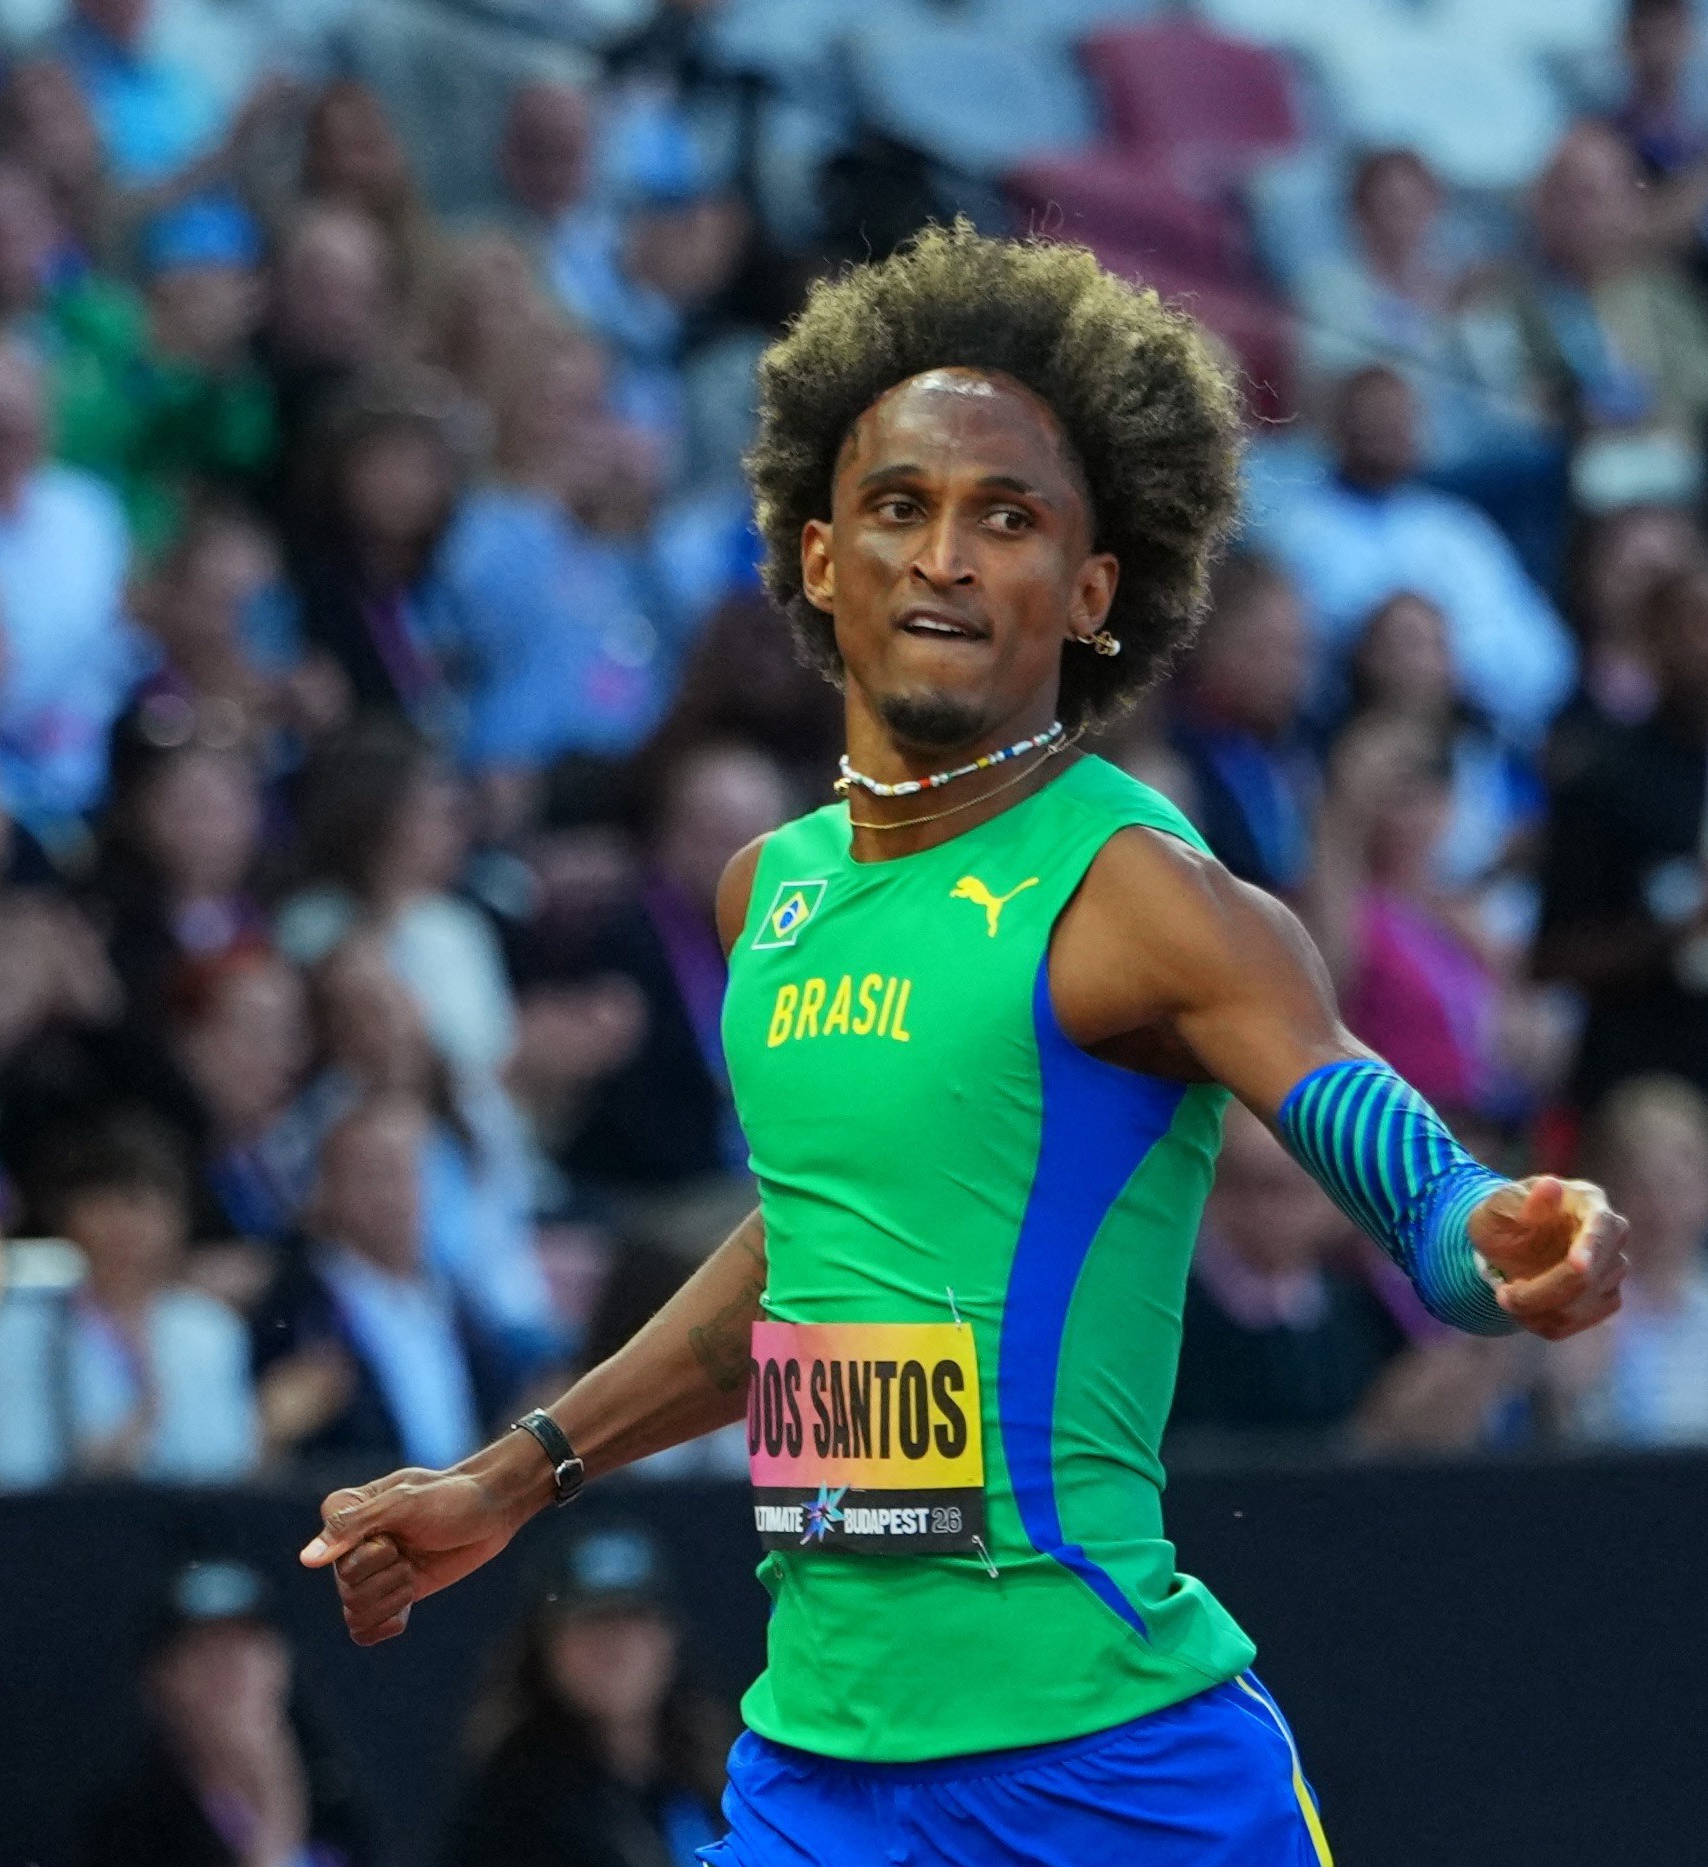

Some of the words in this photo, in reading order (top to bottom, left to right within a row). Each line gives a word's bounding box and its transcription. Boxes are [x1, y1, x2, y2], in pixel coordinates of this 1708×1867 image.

[766, 972, 911, 1048] BRASIL
[748, 1357, 803, 1459] DOS
[810, 1358, 968, 1460] SANTOS
[754, 1506, 804, 1533] LTIMATE
[843, 1507, 930, 1535] BUDAPEST
[931, 1507, 963, 1534] 26
